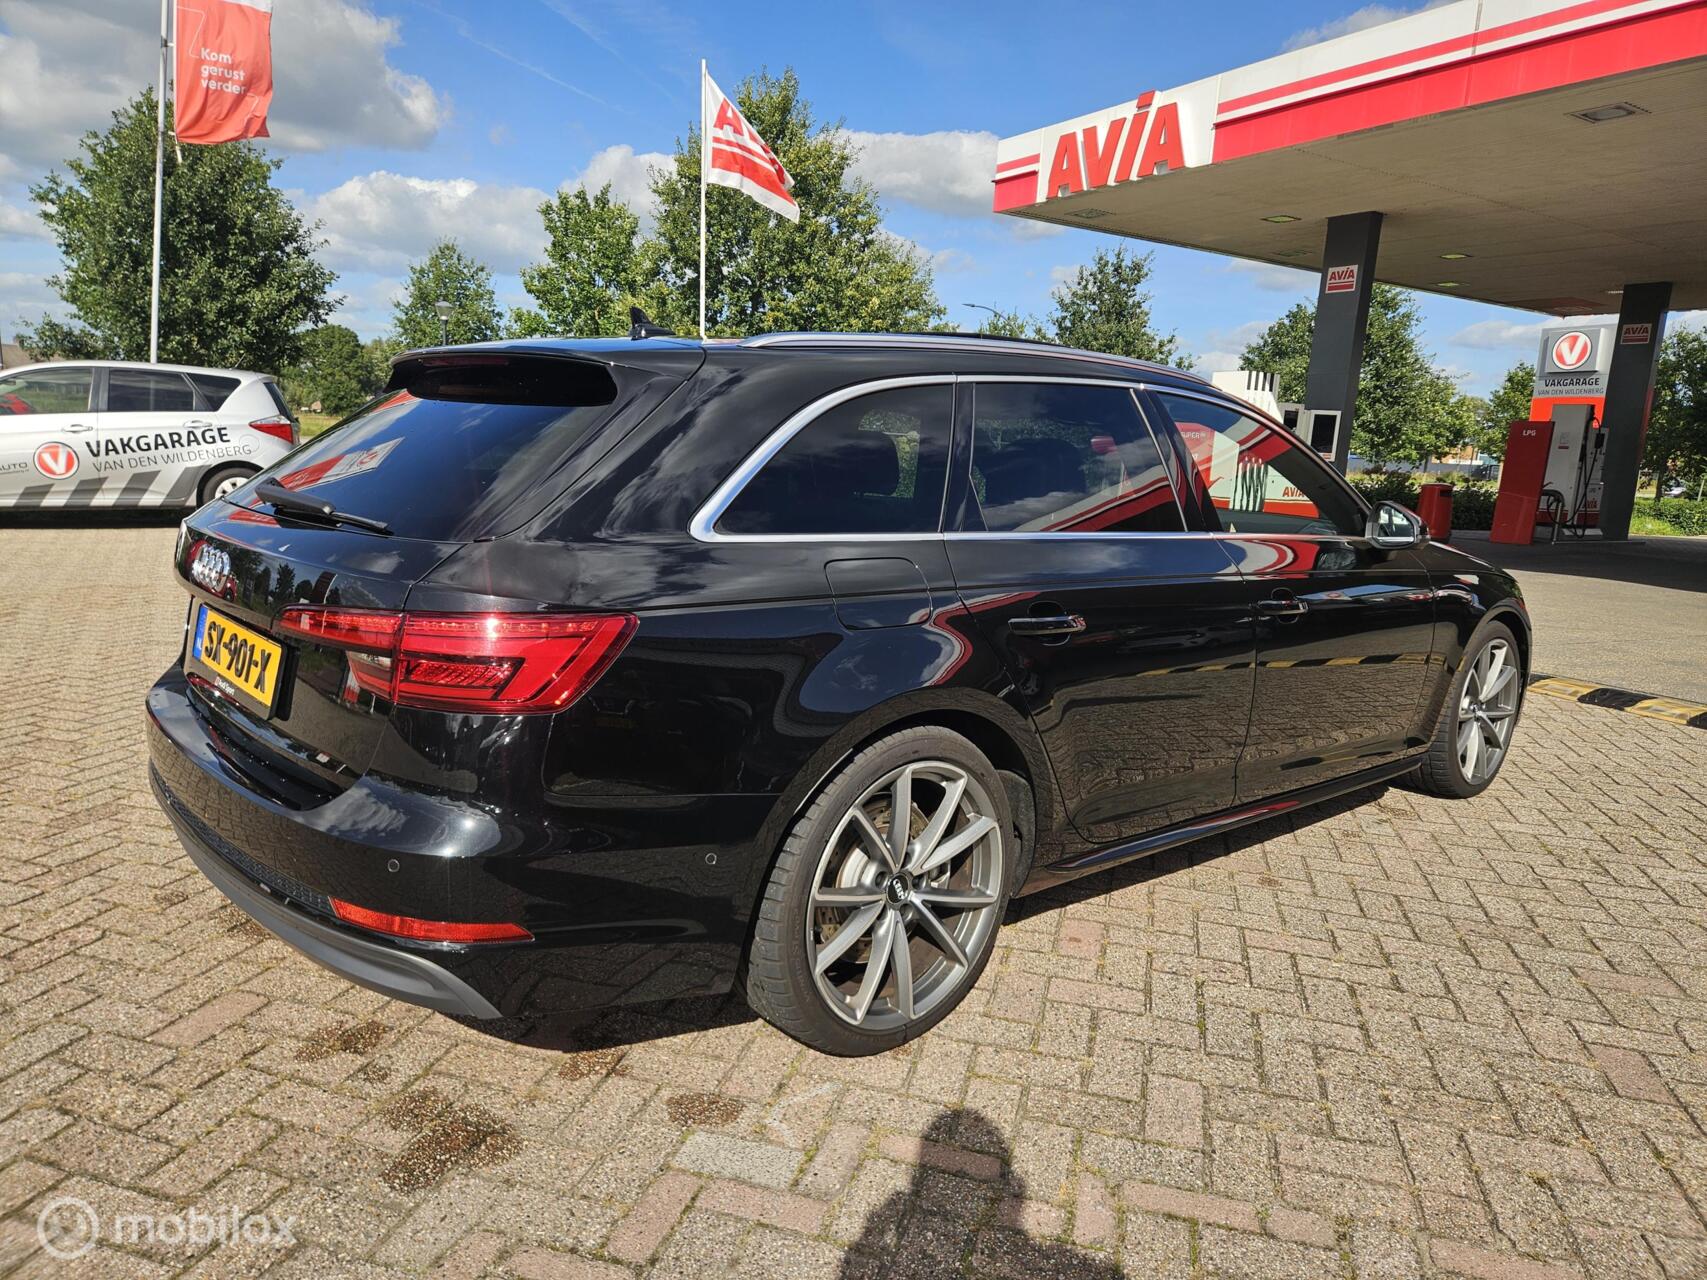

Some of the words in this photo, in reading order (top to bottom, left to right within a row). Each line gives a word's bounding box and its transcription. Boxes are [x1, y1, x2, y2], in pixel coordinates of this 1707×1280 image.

[201, 47, 232, 64] Kom
[201, 64, 246, 80] gerust
[201, 78, 247, 94] verder
[1046, 90, 1185, 199] AVIA
[1329, 267, 1355, 281] AVIA
[1623, 324, 1649, 336] AVIA
[1544, 377, 1600, 387] VAKGARAGE
[1522, 429, 1537, 437] LPG
[85, 426, 231, 458] VAKGARAGE
[93, 459, 124, 473] VAN
[128, 454, 158, 469] DEN
[160, 444, 252, 465] WILDENBERG
[205, 621, 272, 694] SX-901-X
